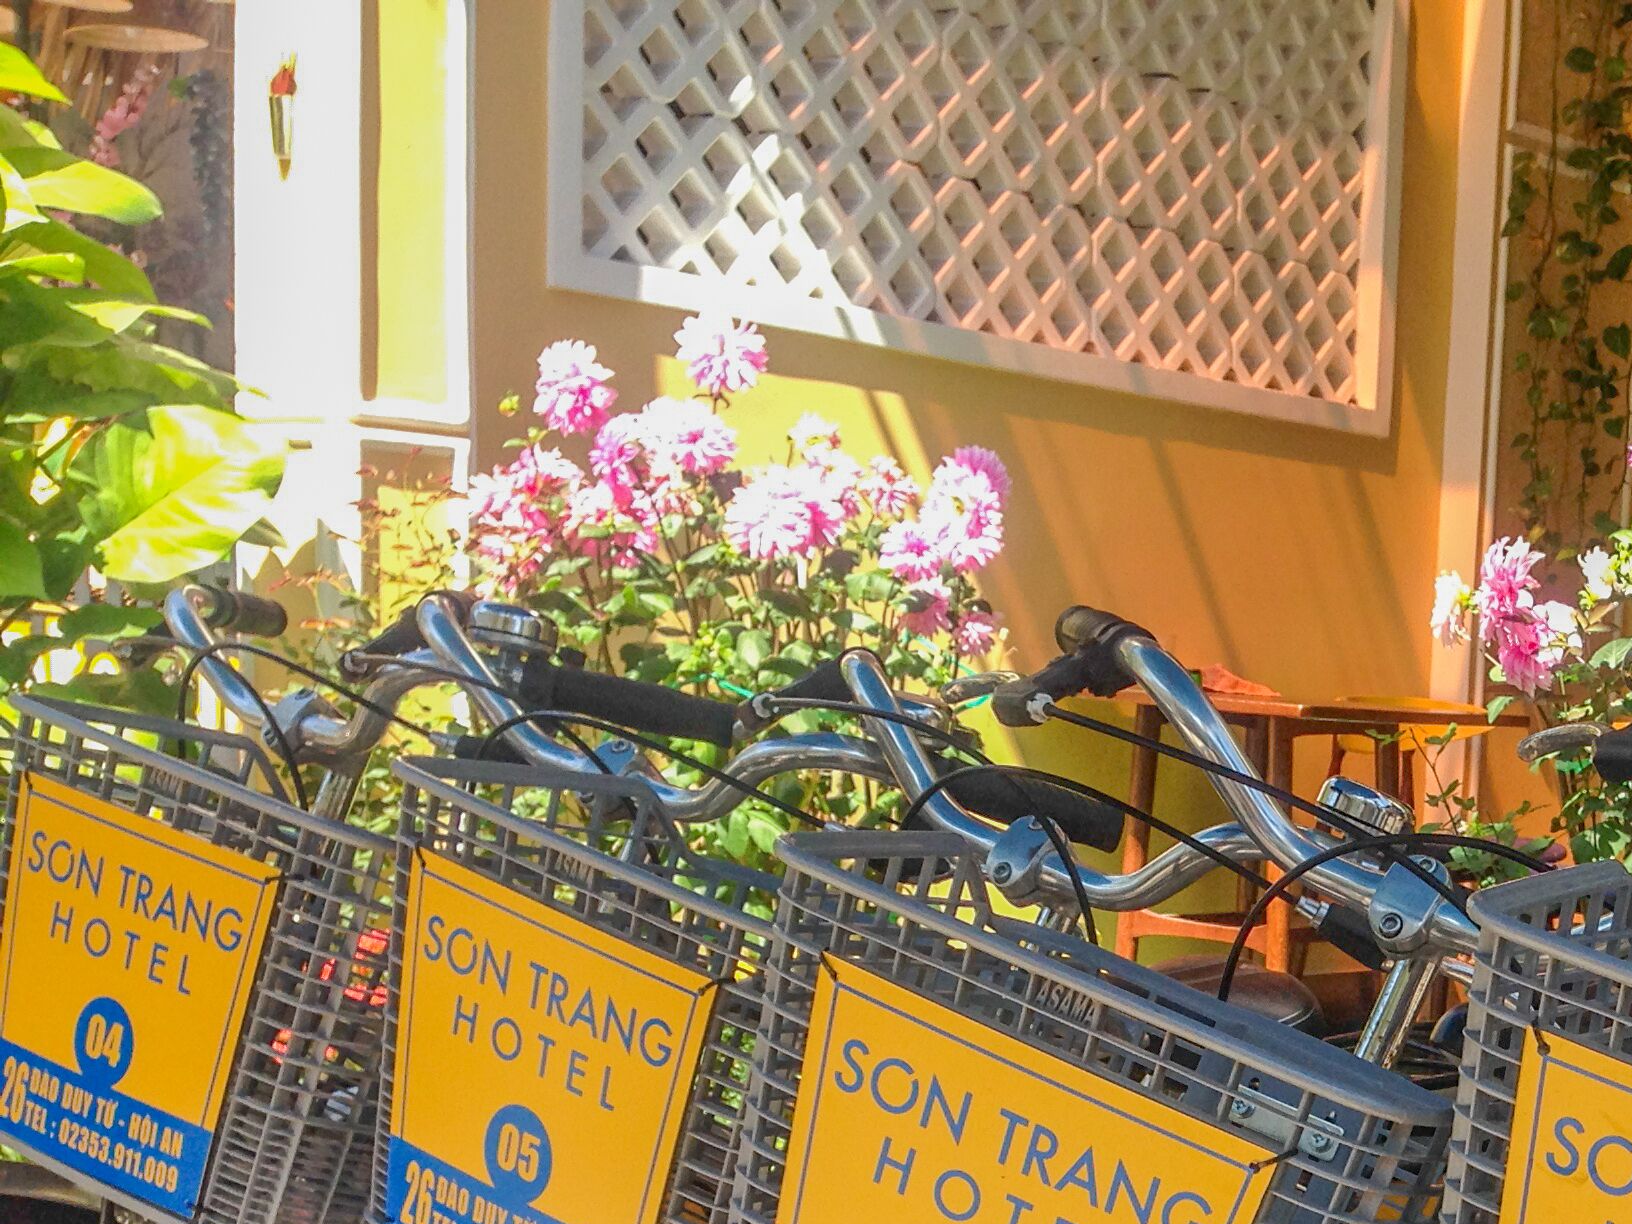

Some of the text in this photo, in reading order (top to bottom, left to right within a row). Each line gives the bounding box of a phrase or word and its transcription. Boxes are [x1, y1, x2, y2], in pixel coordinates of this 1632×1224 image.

[51, 901, 191, 995] HOTEL
[120, 865, 243, 951] TRANG
[86, 1013, 123, 1068] 04
[530, 961, 673, 1067] TRANG
[1034, 981, 1097, 1026] ASAMA
[0, 1056, 30, 1124] 26
[452, 995, 615, 1111] HOTEL
[24, 1100, 48, 1134] TEL
[58, 1118, 179, 1193] 02353.911.009
[61, 1082, 93, 1118] DUY
[159, 1127, 184, 1159] AN
[497, 1122, 541, 1183] 05
